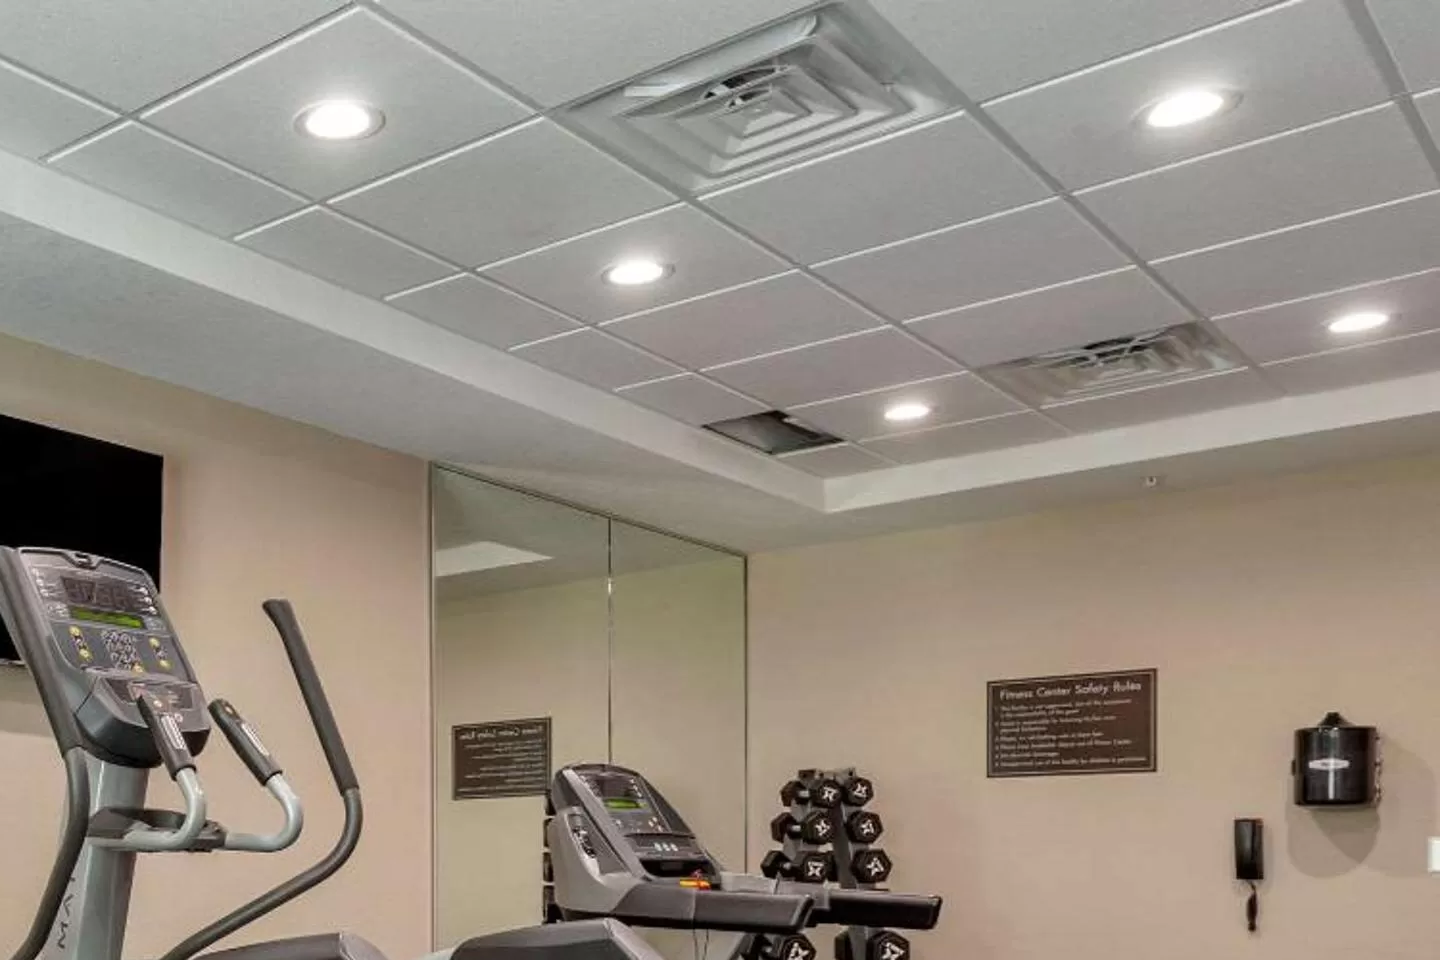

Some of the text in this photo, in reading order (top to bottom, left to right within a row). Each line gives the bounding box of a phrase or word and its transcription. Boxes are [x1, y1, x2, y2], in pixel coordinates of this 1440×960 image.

[1000, 679, 1141, 700] Fitness Center Safety Rules
[57, 877, 76, 949] MA
